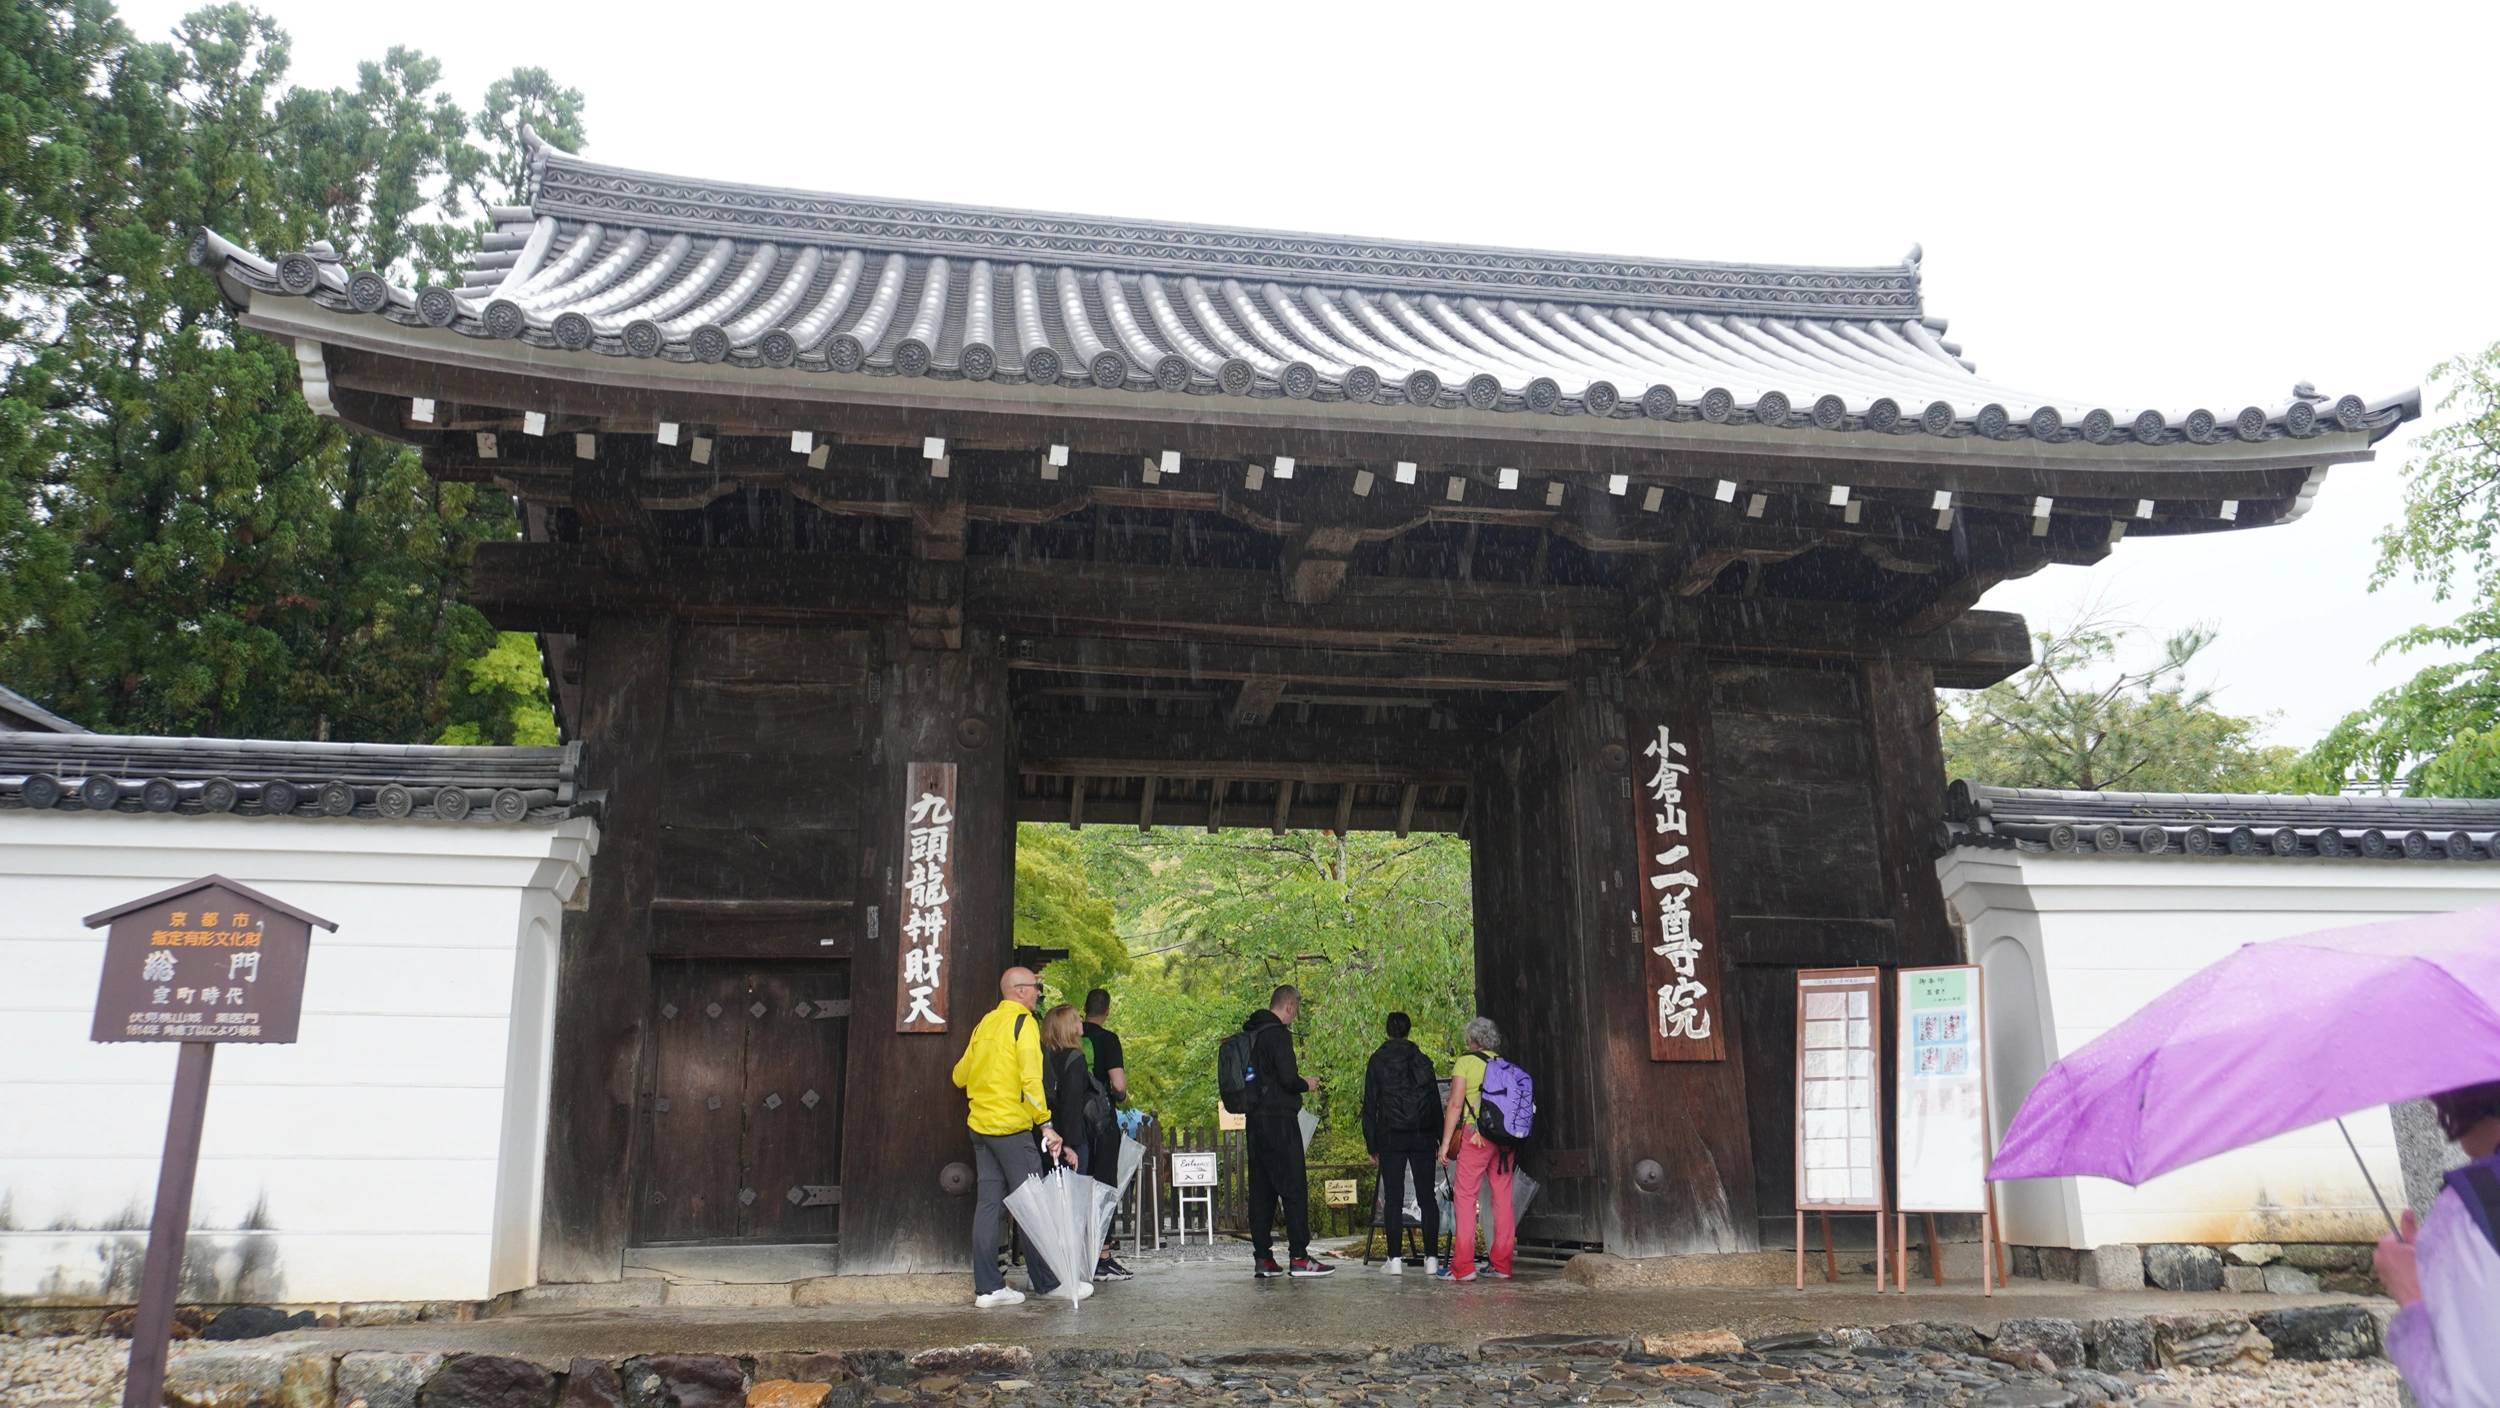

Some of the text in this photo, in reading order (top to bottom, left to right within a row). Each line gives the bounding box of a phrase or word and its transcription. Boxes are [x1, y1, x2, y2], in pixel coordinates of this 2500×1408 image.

[168, 911, 251, 928] 京都市
[151, 930, 263, 947] 指定有形文化財
[152, 985, 243, 1006] 室町時代
[1184, 1173, 1205, 1181] 入口
